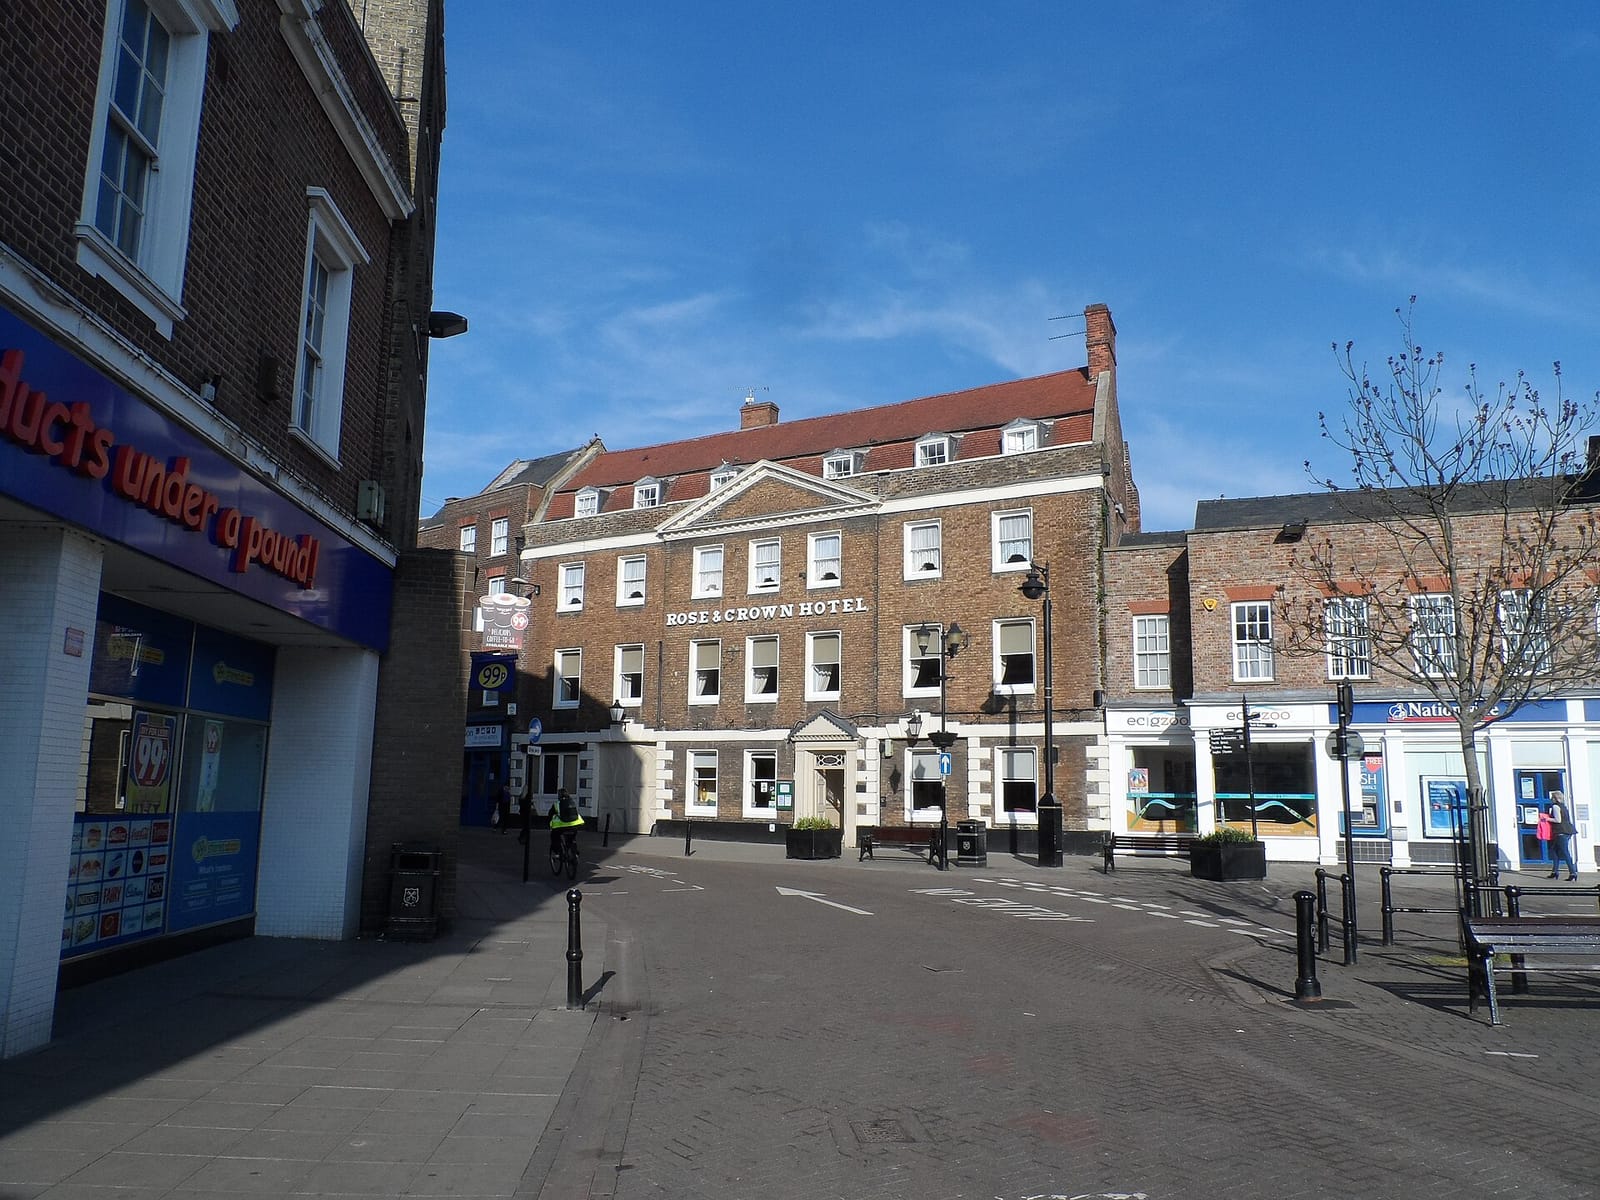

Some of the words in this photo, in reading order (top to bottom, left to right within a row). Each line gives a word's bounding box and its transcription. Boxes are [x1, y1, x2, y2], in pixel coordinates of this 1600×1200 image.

[113, 445, 218, 532] under
[218, 508, 241, 549] a
[237, 517, 320, 589] pound!
[666, 611, 709, 626] ROSE
[712, 611, 722, 623] &
[724, 603, 794, 622] CROWN
[798, 598, 868, 616] HOTEL
[483, 666, 506, 685] 99p
[1365, 757, 1383, 765] FREE
[1361, 774, 1377, 784] SH
